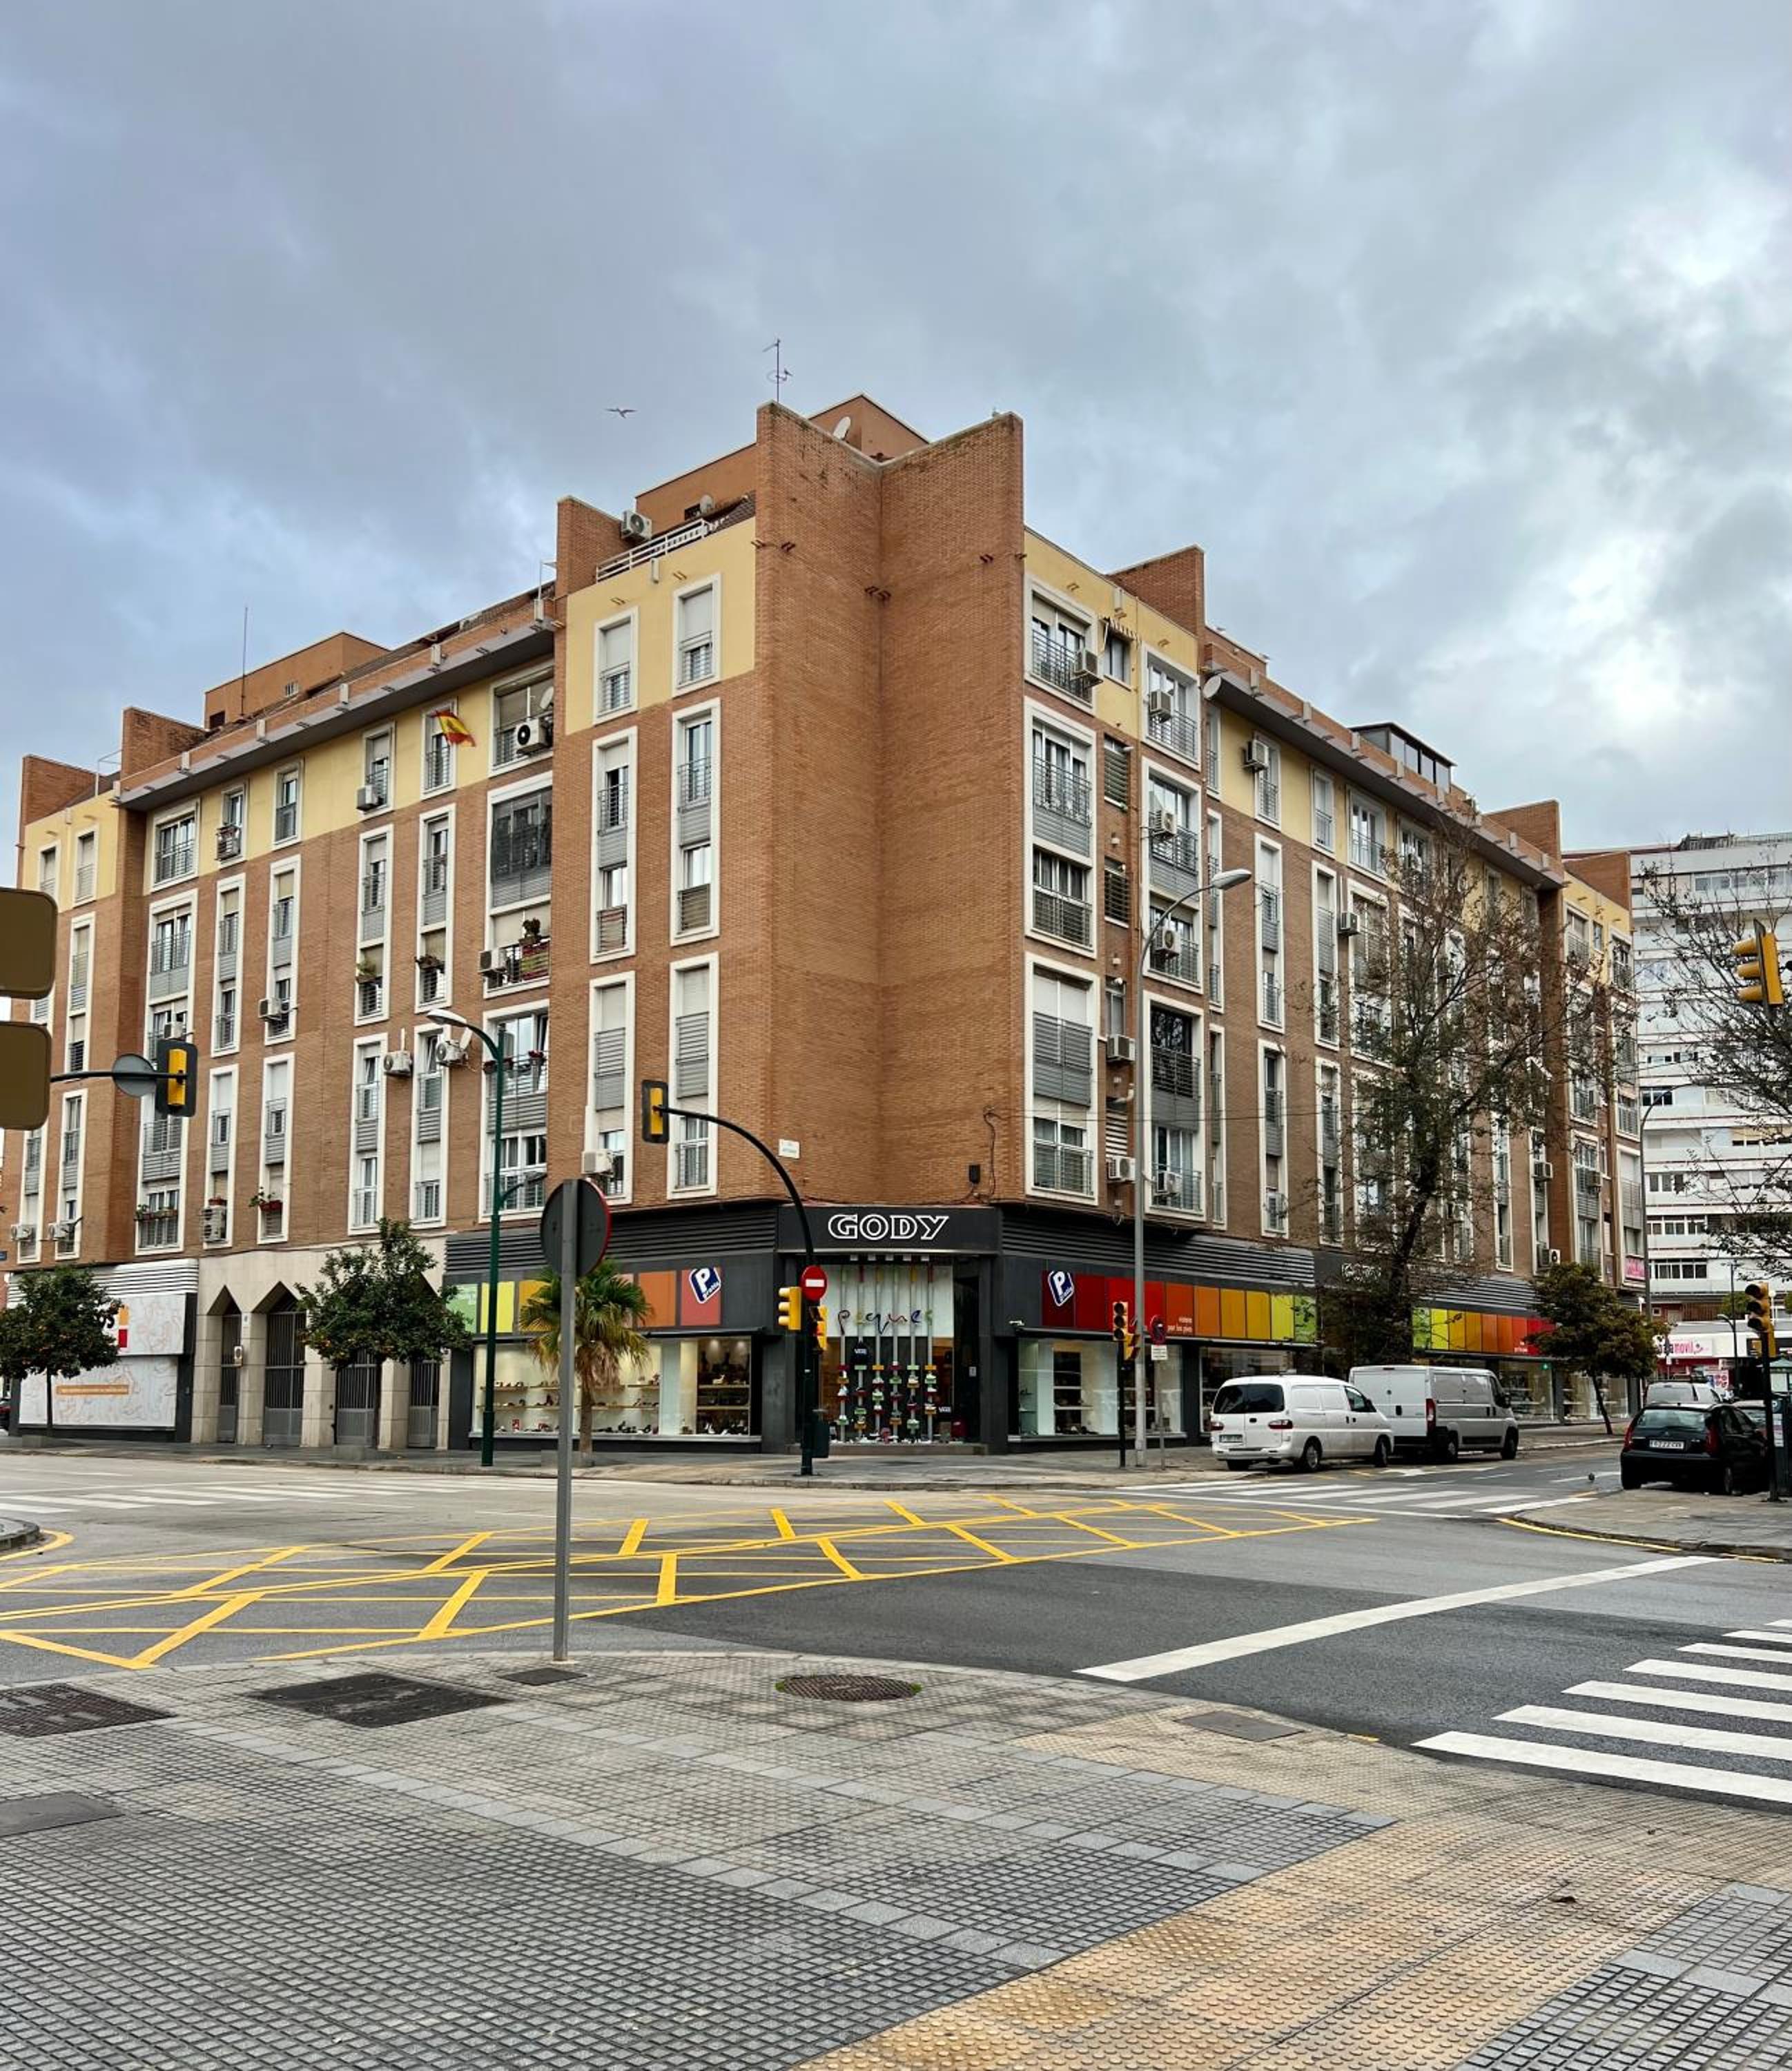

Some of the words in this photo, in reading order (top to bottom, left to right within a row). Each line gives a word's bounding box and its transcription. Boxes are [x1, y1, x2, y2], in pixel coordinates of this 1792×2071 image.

[828, 1214, 949, 1241] GODY
[695, 1267, 710, 1293] P
[1053, 1271, 1065, 1295] P
